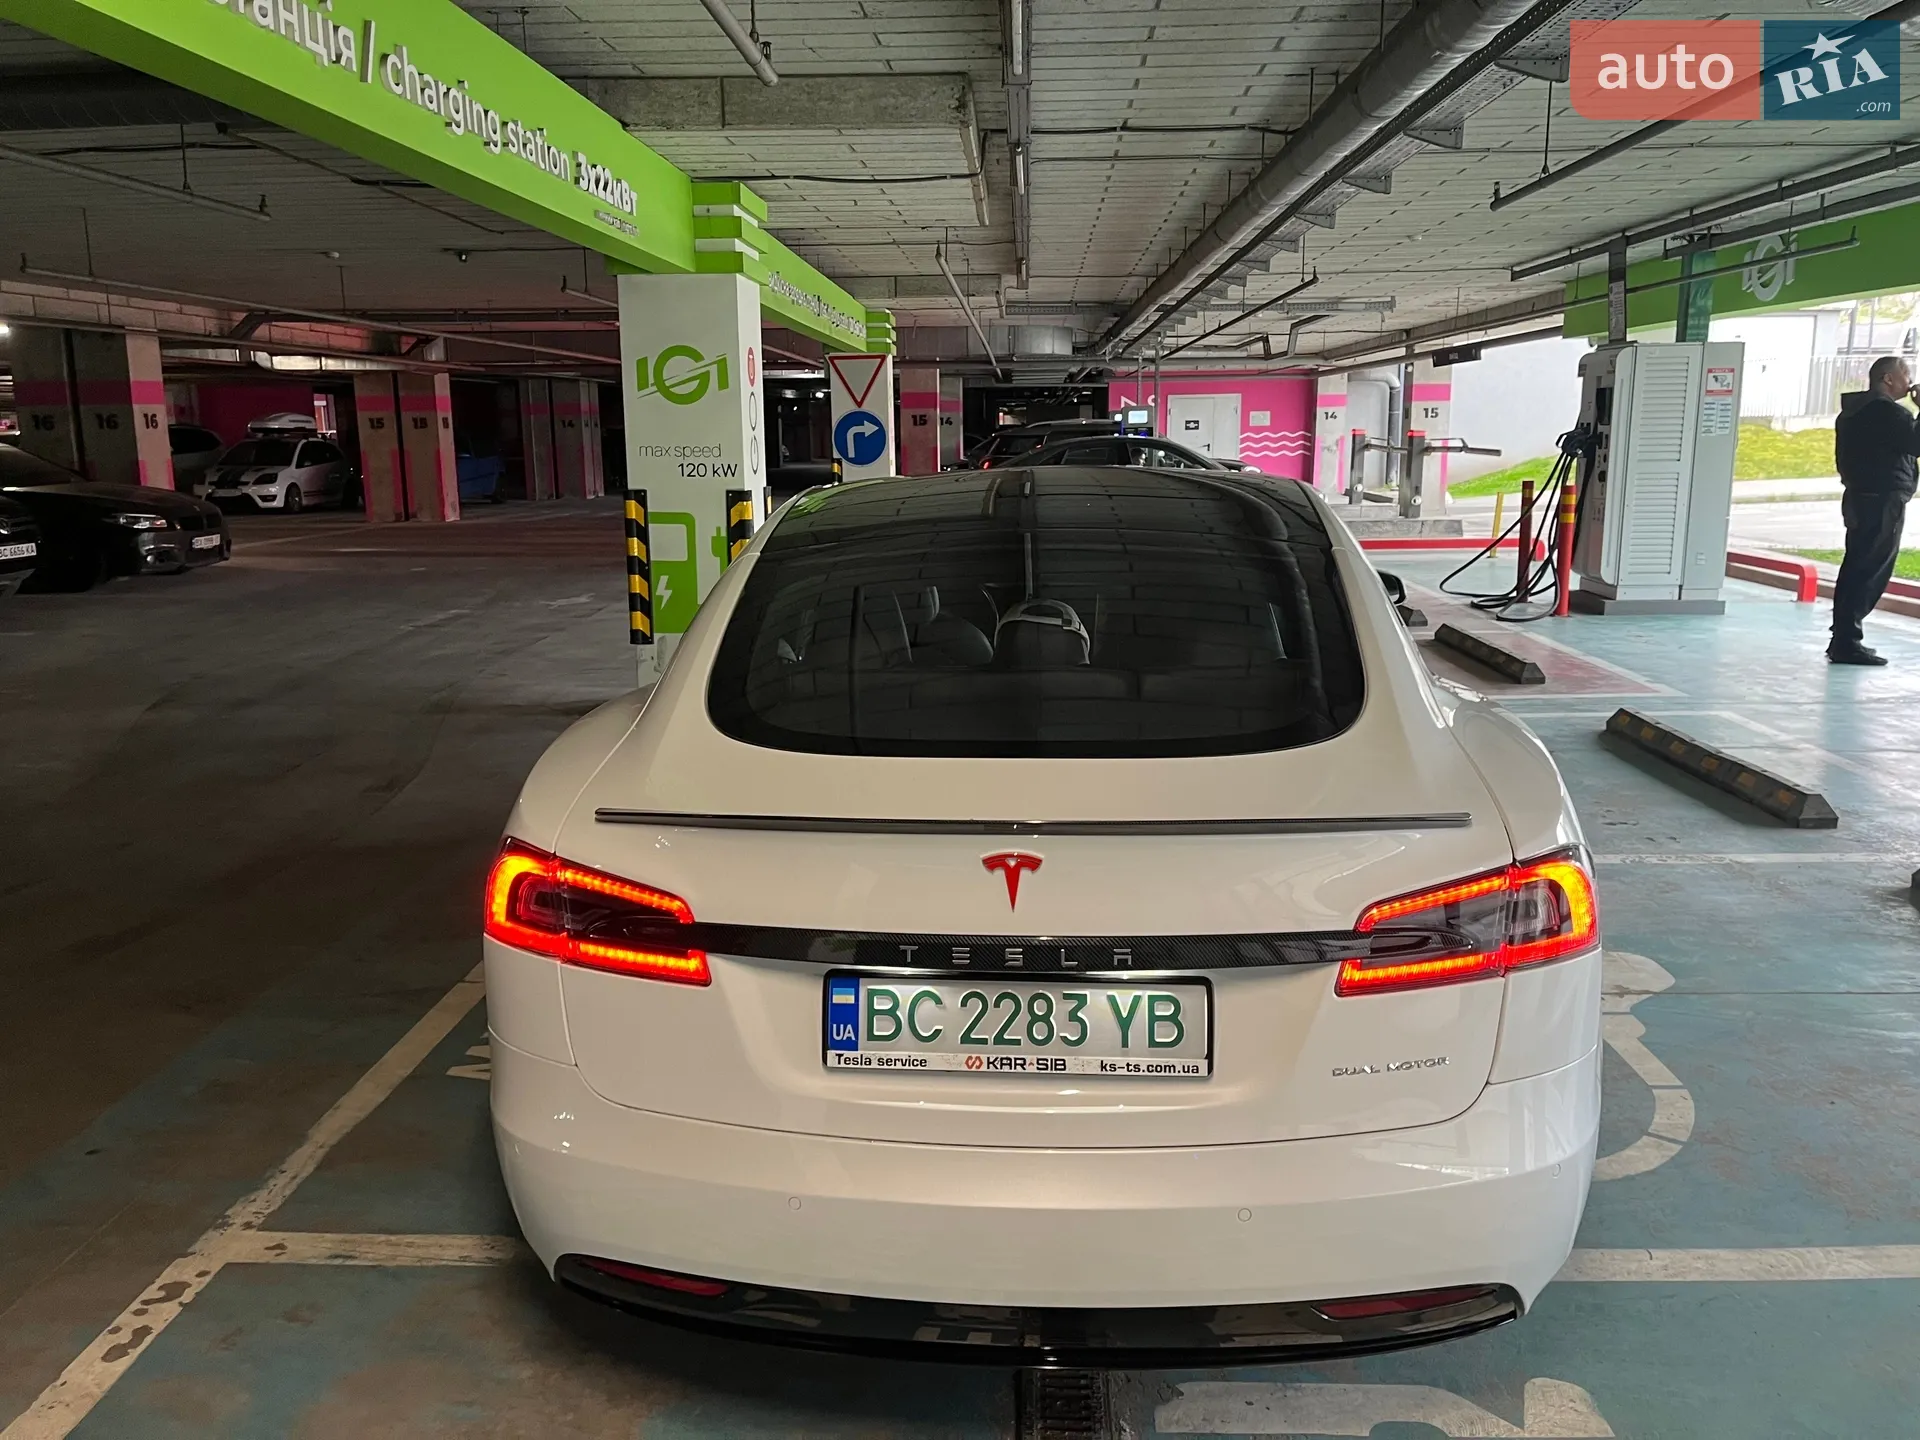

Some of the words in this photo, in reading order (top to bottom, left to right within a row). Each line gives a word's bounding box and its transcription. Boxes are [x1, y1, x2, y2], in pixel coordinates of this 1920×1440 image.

[204, 0, 357, 72] анція
[380, 44, 501, 154] charging
[503, 118, 571, 182] station
[143, 413, 159, 430] 16
[911, 414, 928, 427] 15
[940, 416, 954, 426] 14
[1324, 411, 1338, 421] 14
[1423, 407, 1439, 419] 15
[32, 413, 56, 431] 16
[95, 413, 119, 431] 16
[368, 416, 385, 430] 15
[639, 445, 672, 457] max
[674, 443, 722, 460] speed
[677, 462, 708, 478] 120
[712, 462, 738, 478] kW
[899, 945, 1133, 968] TESLA
[866, 986, 944, 1044] BC
[958, 989, 1091, 1048] 2283
[1106, 991, 1187, 1049] YB
[832, 1023, 856, 1042] UA
[835, 1053, 873, 1067] Tesla
[877, 1055, 928, 1068] service
[1100, 1059, 1200, 1074] ks-ts.com.ua
[1331, 1064, 1382, 1077] DUAL
[1386, 1056, 1451, 1073] MOTOR
